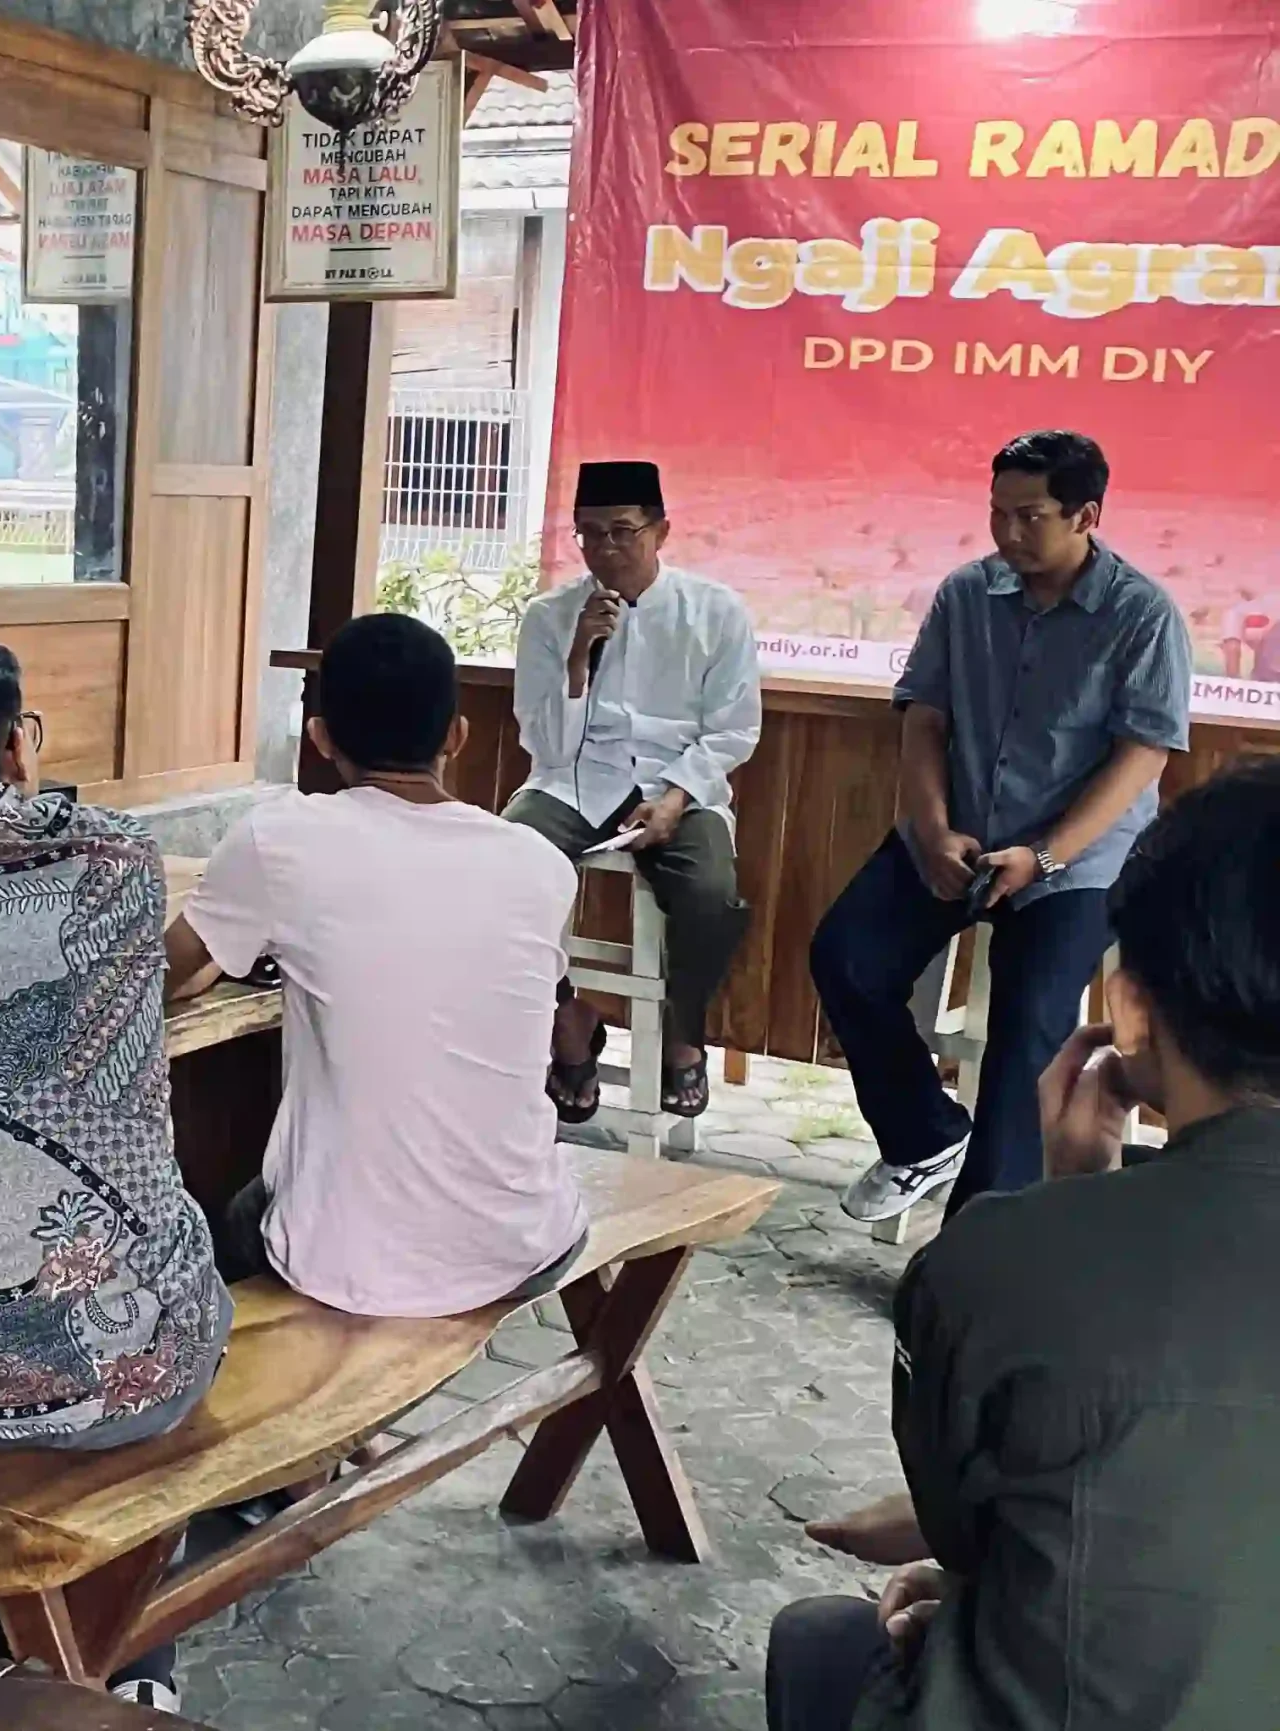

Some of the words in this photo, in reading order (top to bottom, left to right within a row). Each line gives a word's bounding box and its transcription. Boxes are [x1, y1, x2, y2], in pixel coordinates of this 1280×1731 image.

[363, 128, 426, 146] DAPAT
[663, 119, 938, 178] SERIAL
[968, 116, 1280, 179] RAMAD
[303, 167, 360, 185] MASA
[329, 187, 360, 200] TAPI
[364, 186, 395, 198] KITA
[291, 205, 343, 219] DAPAT
[291, 224, 352, 243] MASA
[360, 221, 432, 242] DEPAN
[643, 217, 941, 313] Ngaji
[950, 228, 1280, 318] Agra
[802, 335, 935, 374] DPD
[953, 340, 1081, 379] IMM
[1102, 346, 1215, 384] DIY
